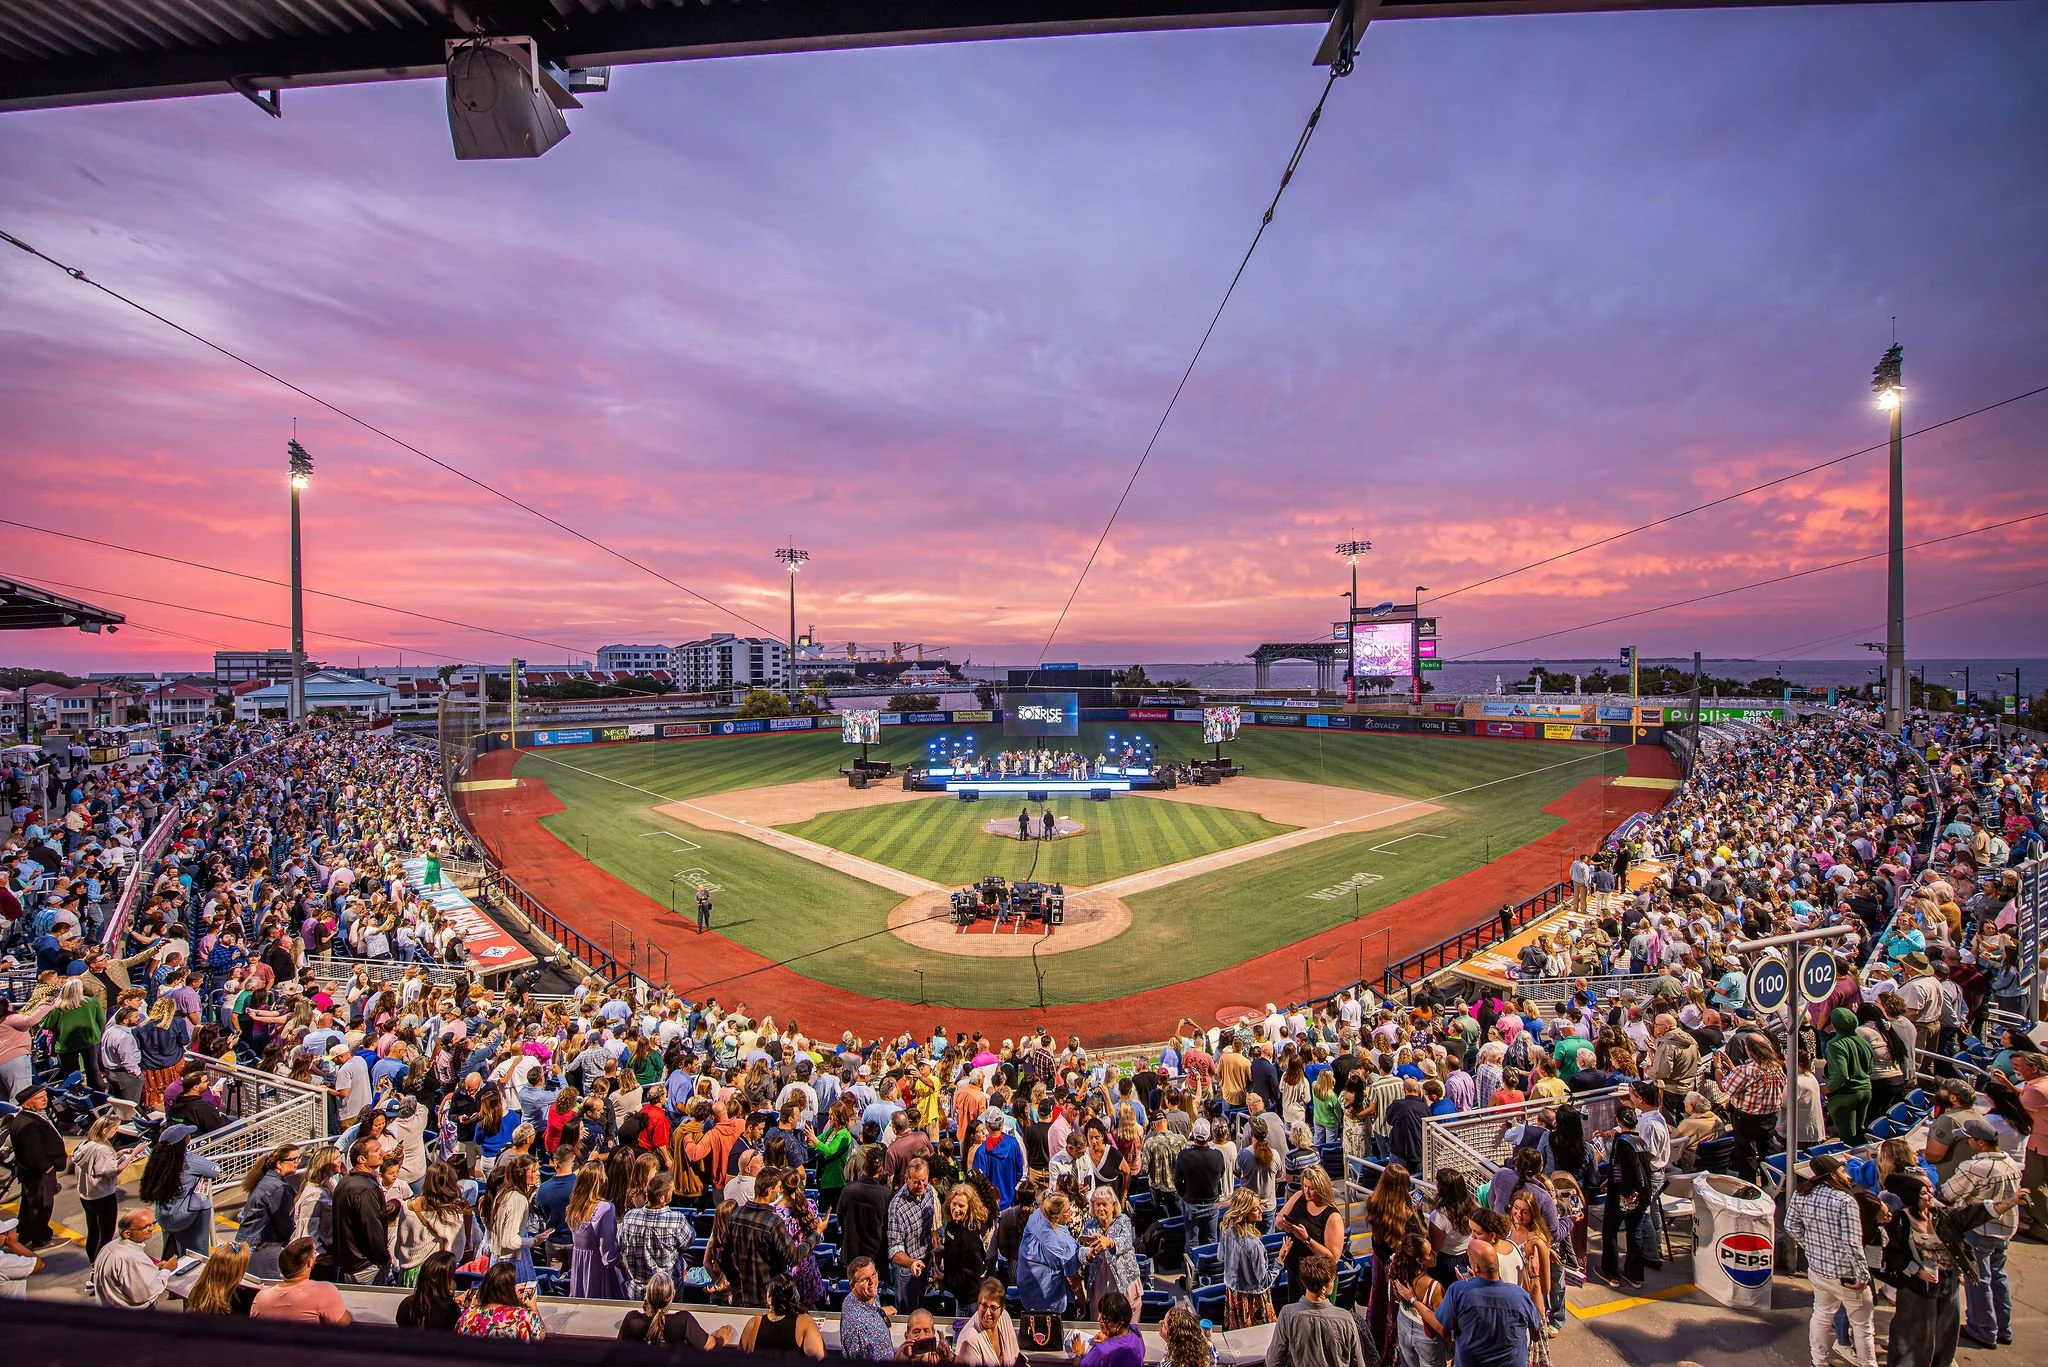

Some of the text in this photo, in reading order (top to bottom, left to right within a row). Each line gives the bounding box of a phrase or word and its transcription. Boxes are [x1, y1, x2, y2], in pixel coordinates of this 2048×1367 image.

[1356, 642, 1409, 657] SONRISE
[1018, 708, 1062, 720] SONRISE
[1758, 974, 1784, 994] 100
[1807, 965, 1832, 985] 102
[1721, 1247, 1772, 1267] PEPSI
